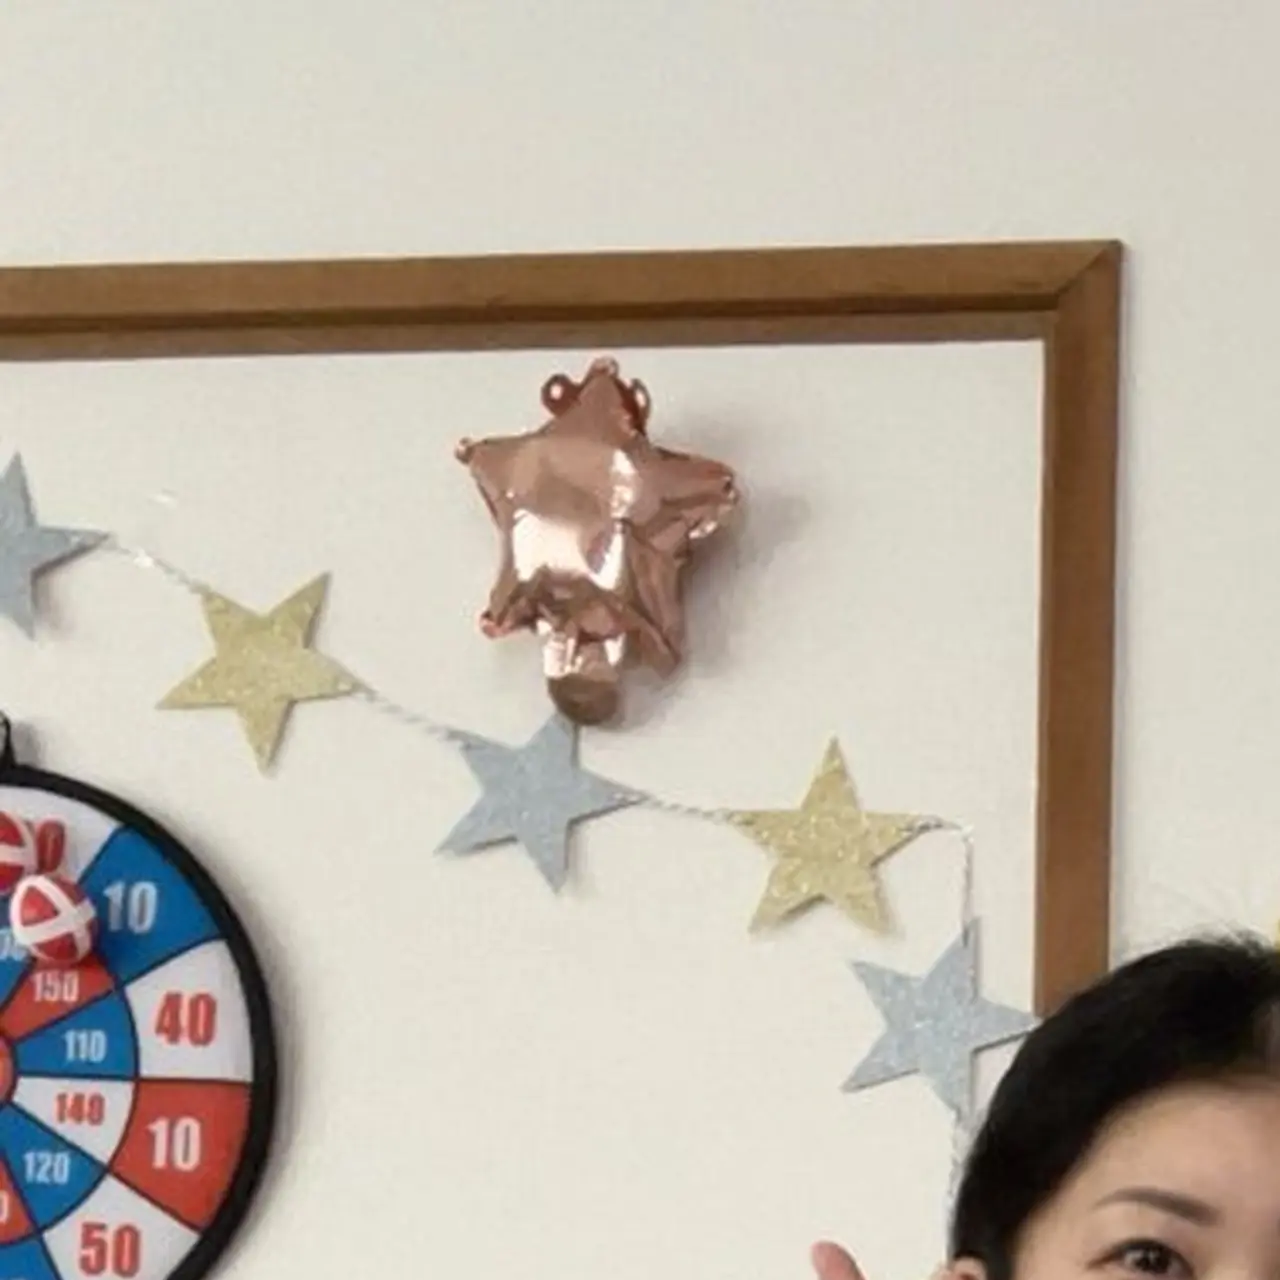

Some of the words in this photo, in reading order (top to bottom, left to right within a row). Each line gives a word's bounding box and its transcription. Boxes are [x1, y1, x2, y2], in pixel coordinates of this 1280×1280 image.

[103, 880, 157, 933] 10
[33, 968, 80, 1002] 150
[155, 990, 217, 1047] 40
[63, 1028, 107, 1062] 110
[56, 1092, 106, 1126] 140
[146, 1115, 202, 1172] 10
[23, 1151, 71, 1185] 120
[78, 1221, 141, 1279] 50
